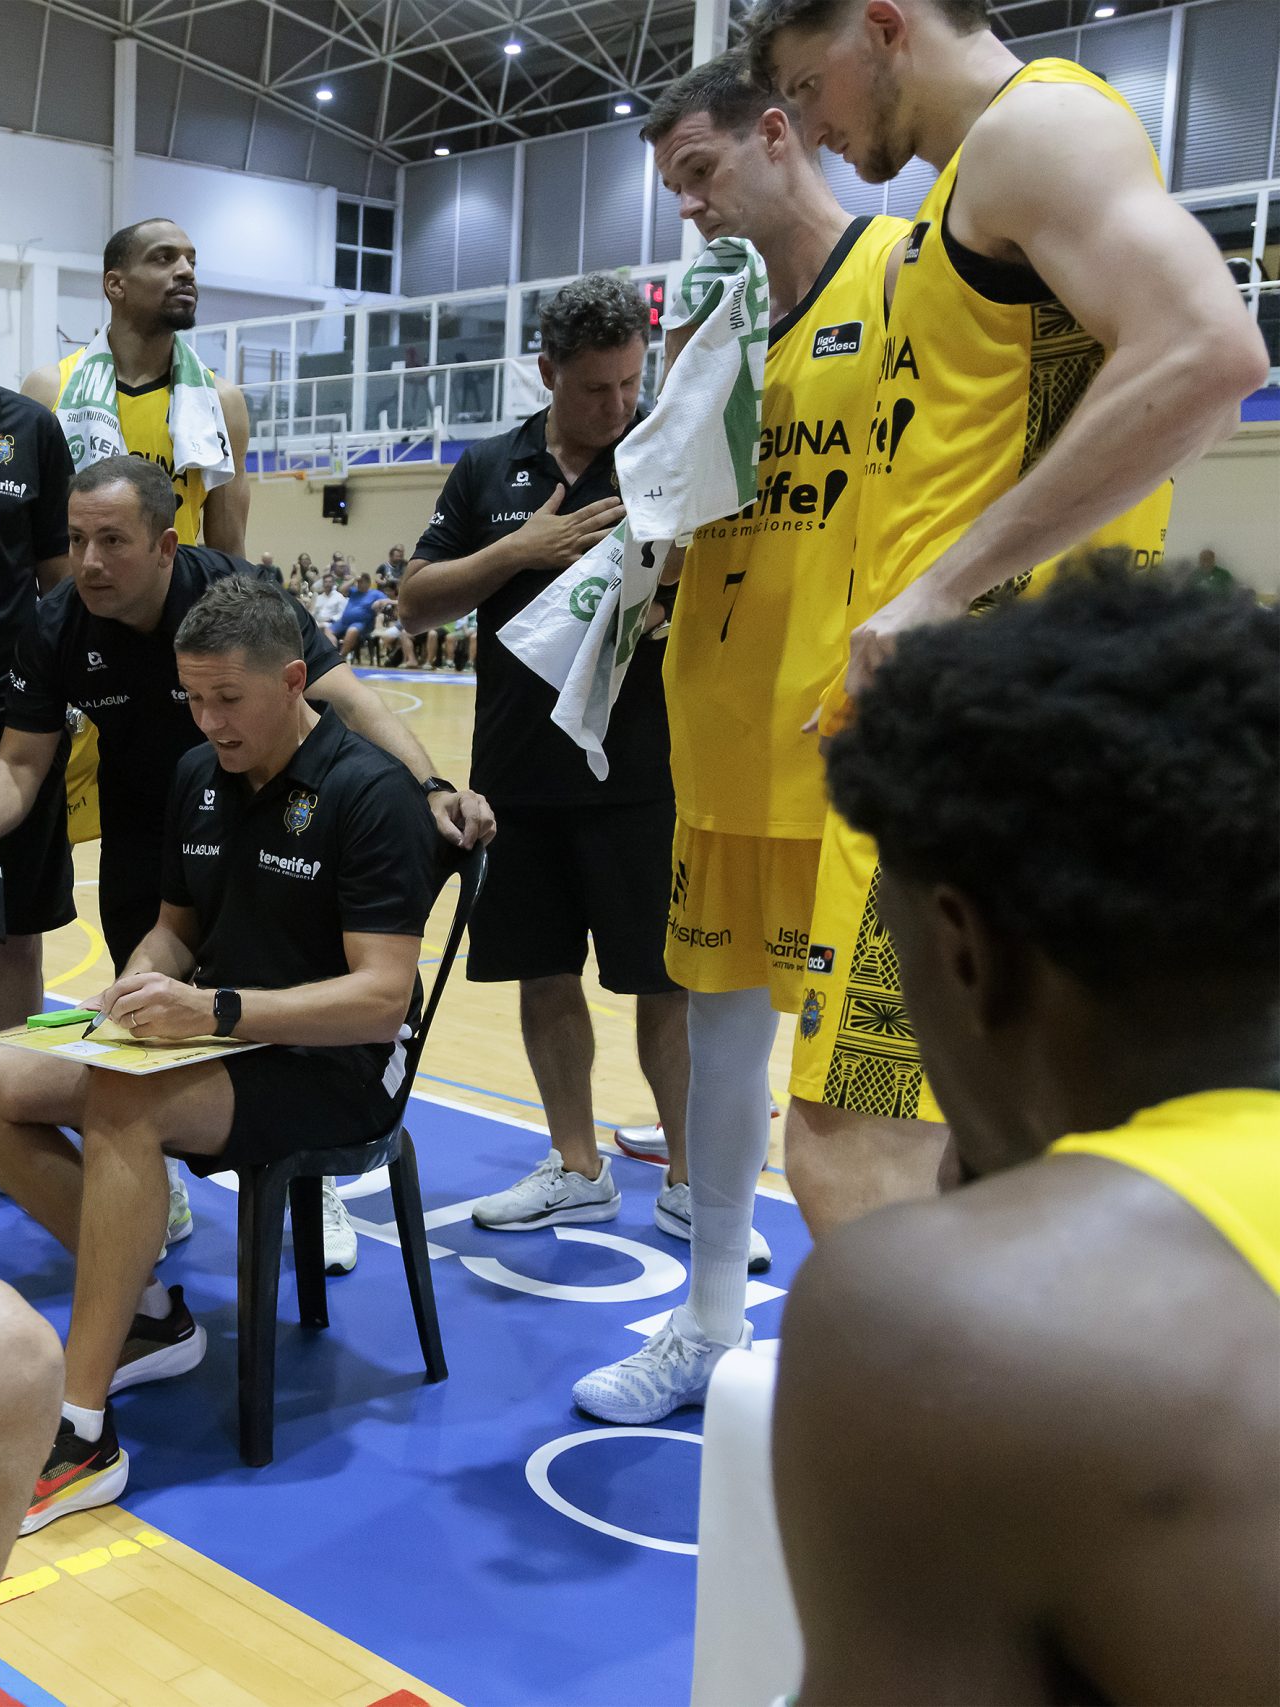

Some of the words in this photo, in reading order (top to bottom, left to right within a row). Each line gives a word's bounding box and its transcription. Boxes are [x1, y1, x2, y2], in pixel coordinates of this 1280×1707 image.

[817, 334, 836, 346] liga
[815, 341, 857, 355] endesa
[491, 513, 503, 523] LA
[723, 570, 747, 643] 7
[78, 700, 93, 709] LA
[93, 694, 130, 709] LAGUNA
[182, 843, 191, 855] LA
[190, 844, 220, 855] LAGUNA
[778, 927, 809, 945] Isla
